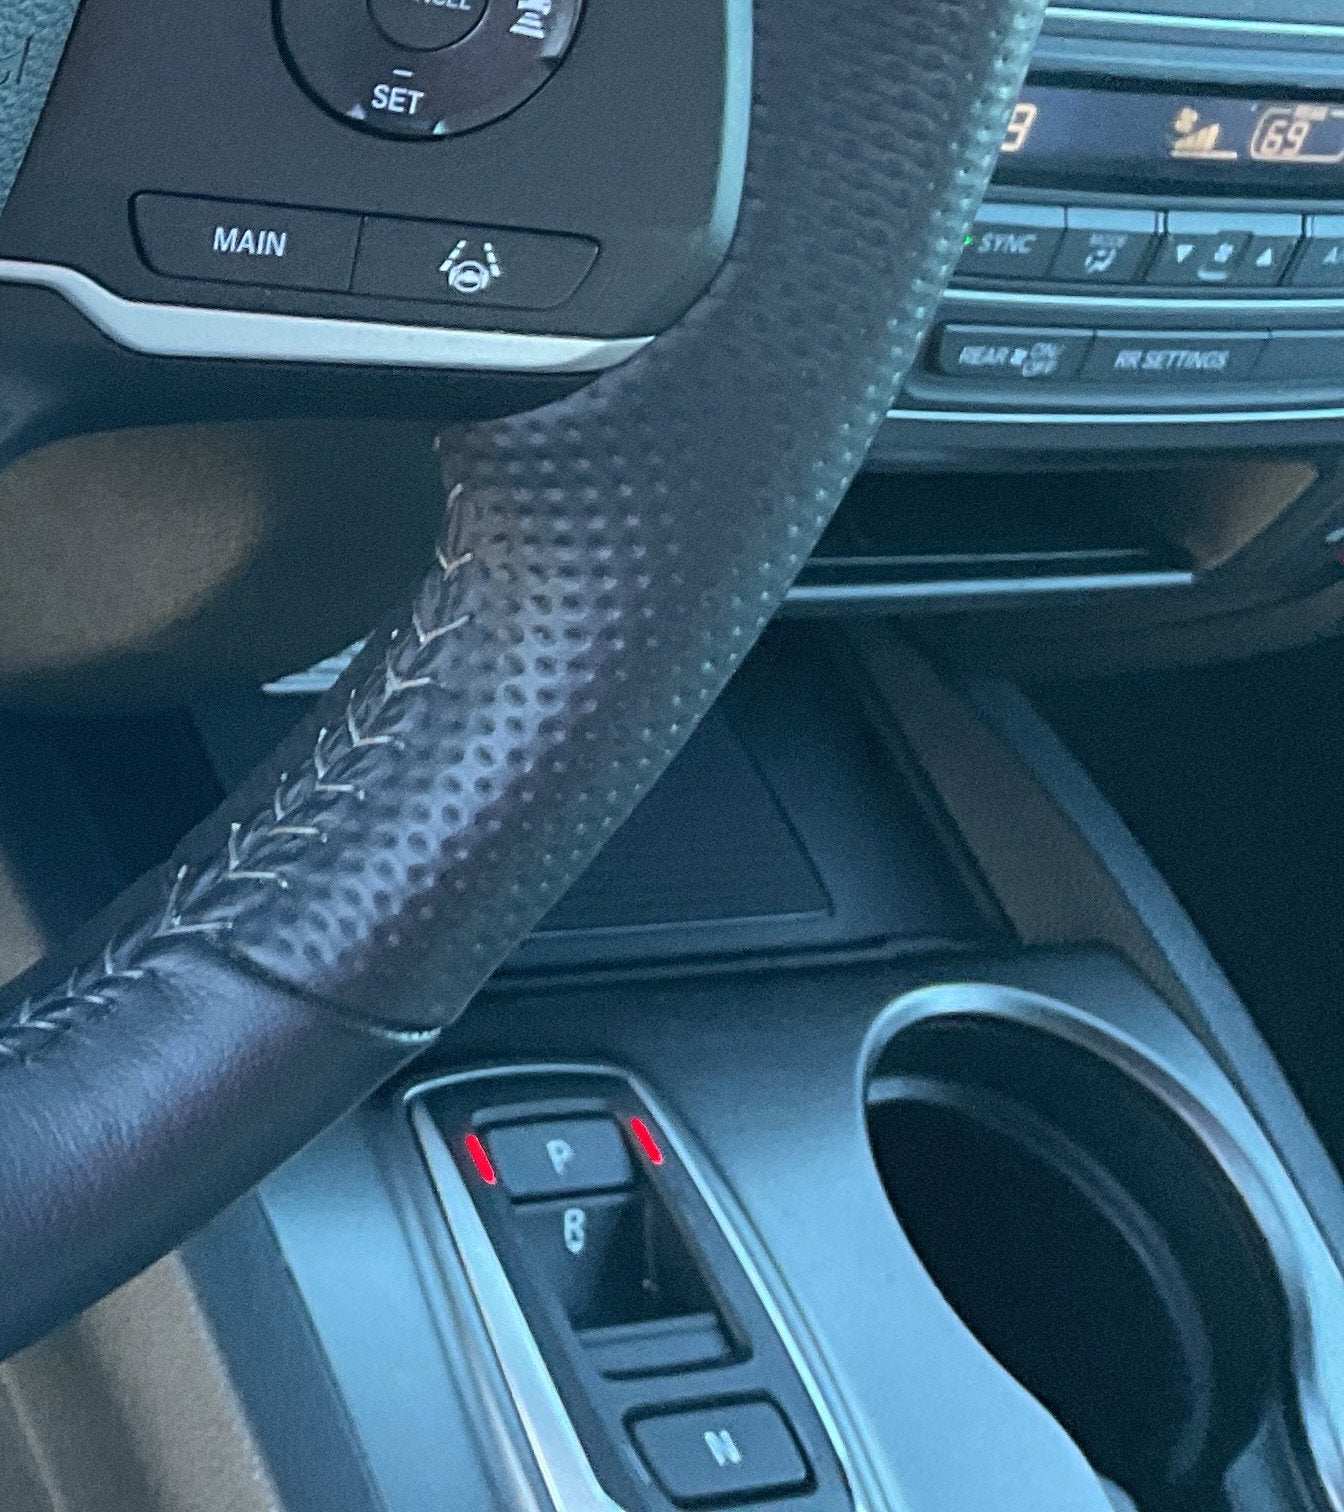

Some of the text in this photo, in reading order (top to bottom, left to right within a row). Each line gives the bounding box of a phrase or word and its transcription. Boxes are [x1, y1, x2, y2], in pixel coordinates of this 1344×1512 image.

[370, 83, 425, 116] SET
[211, 225, 288, 258] MAIN
[977, 231, 1038, 255] SYNC
[545, 1138, 576, 1176] P
[702, 1428, 743, 1468] N
